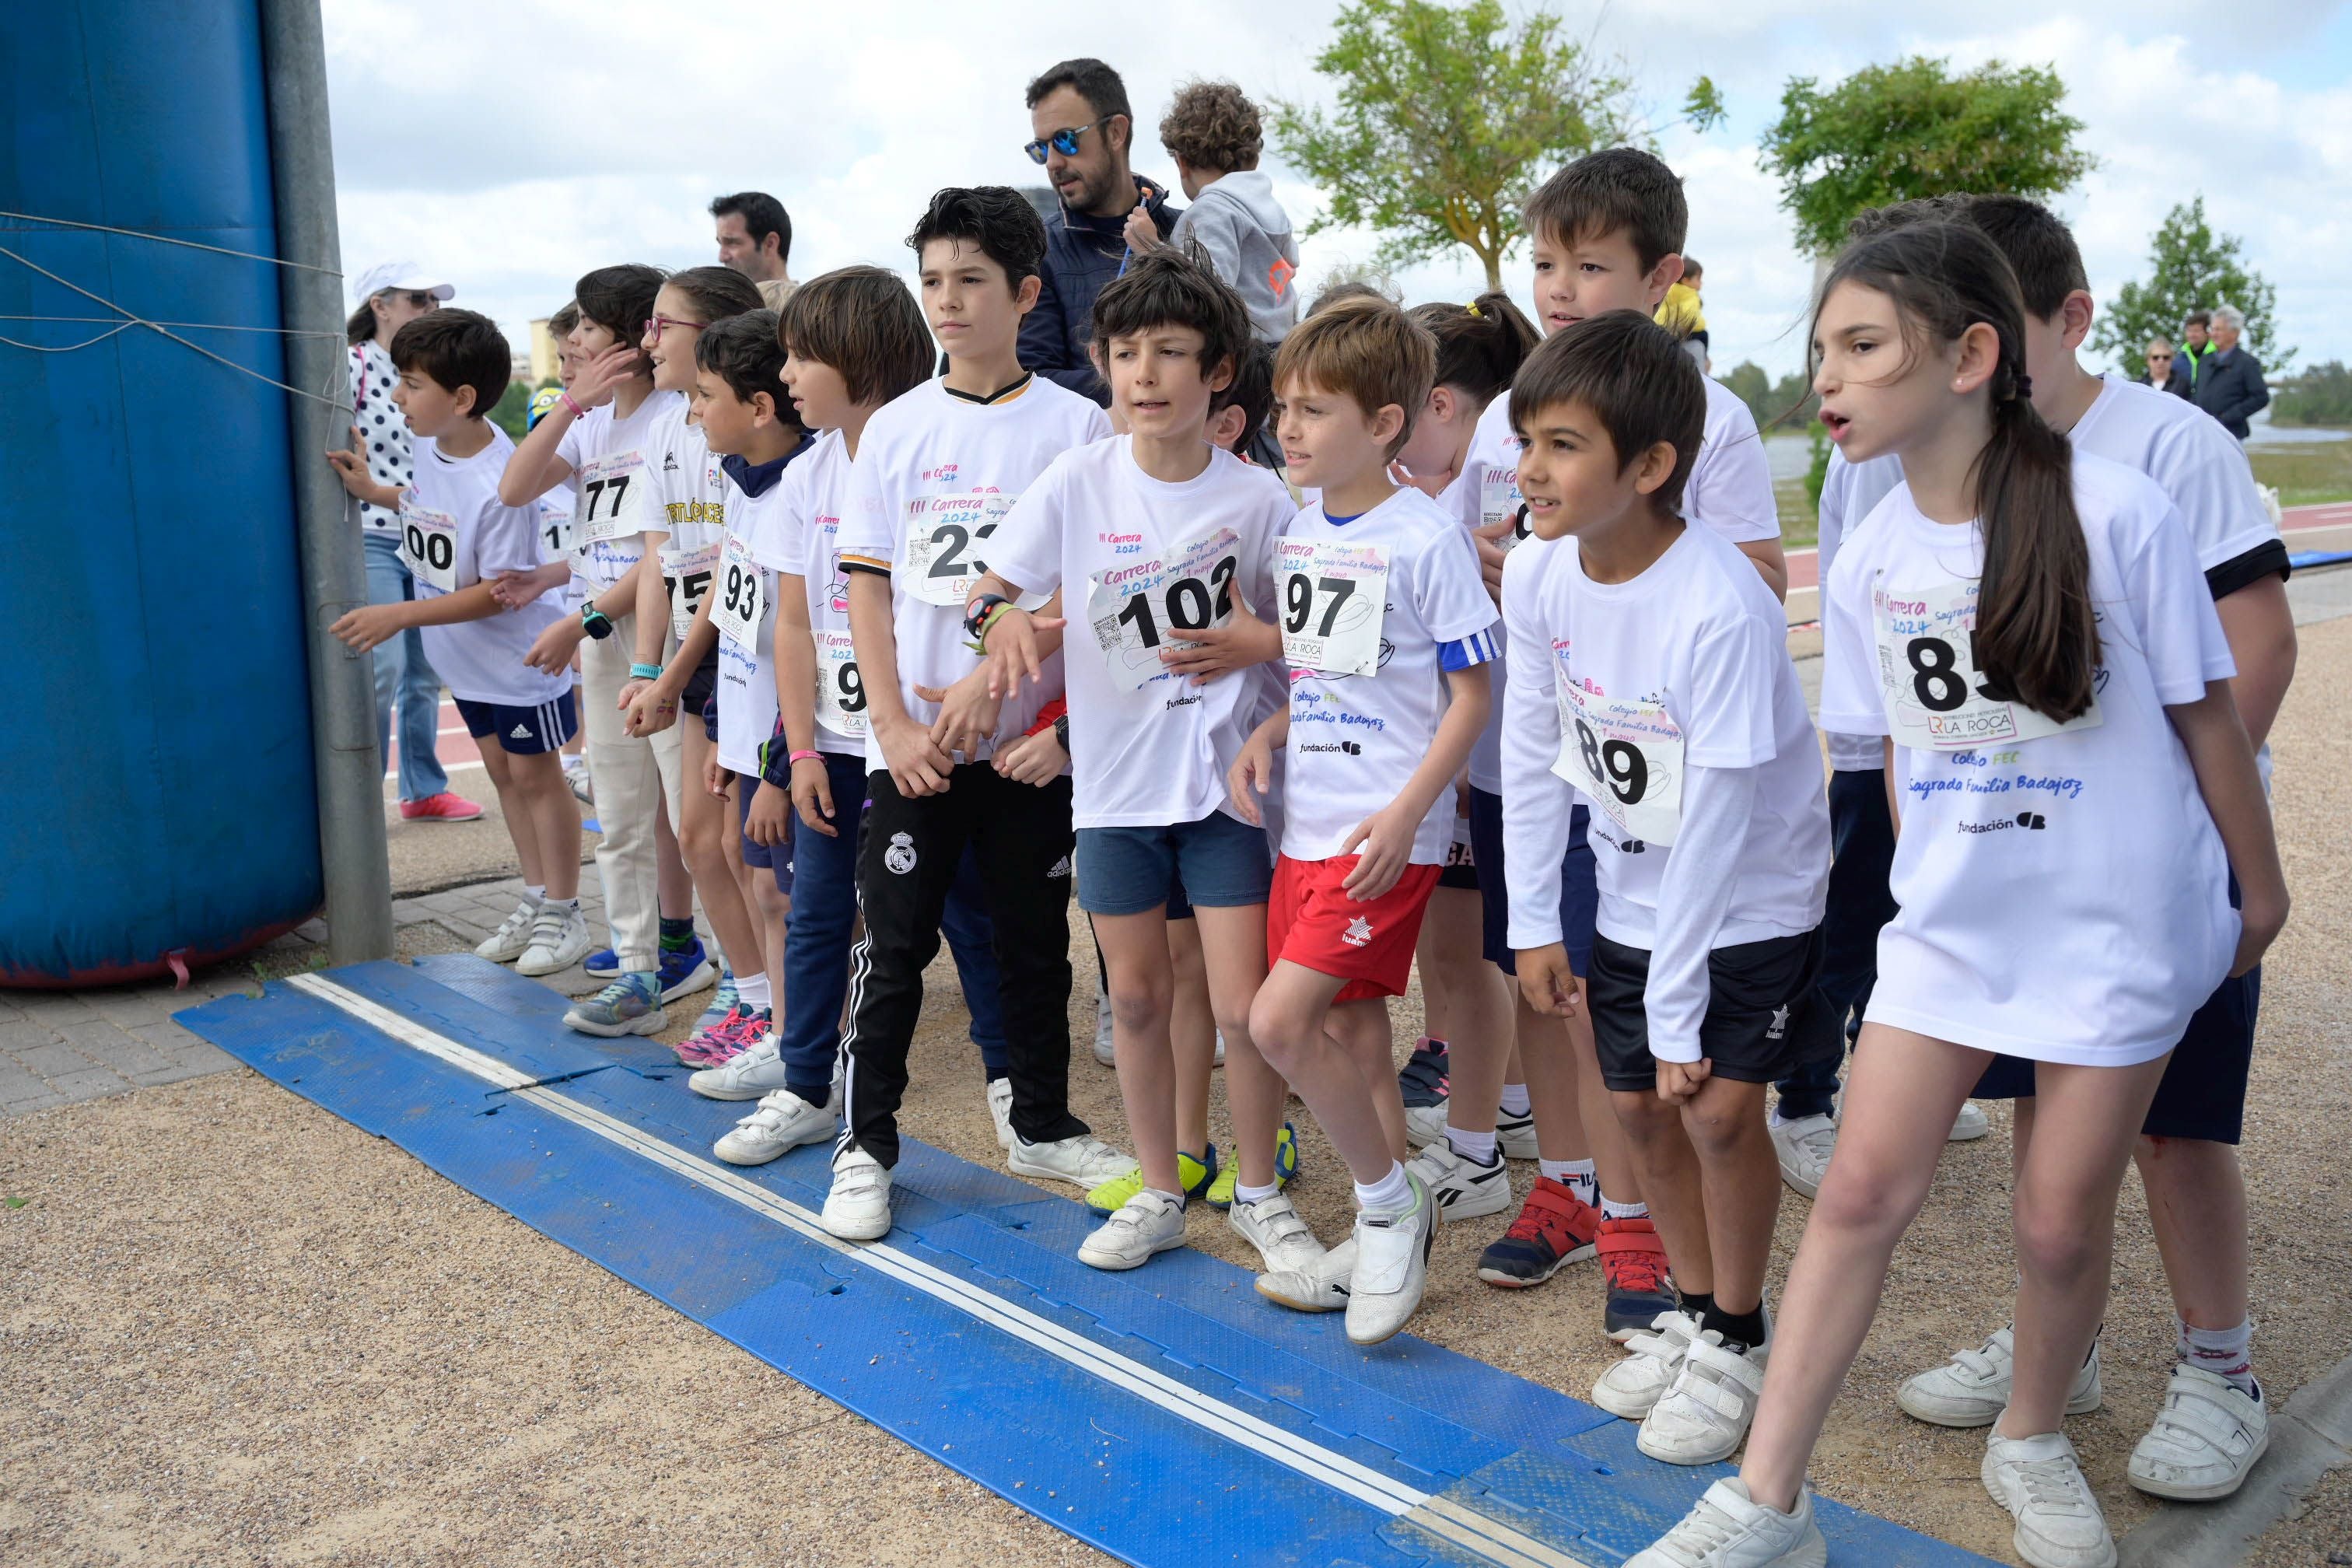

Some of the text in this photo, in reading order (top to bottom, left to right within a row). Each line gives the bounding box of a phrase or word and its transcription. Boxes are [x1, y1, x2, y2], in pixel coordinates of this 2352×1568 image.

[922, 471, 931, 481] III
[1486, 470, 1502, 483] III
[586, 475, 630, 522] 77
[910, 498, 984, 514] III Carrera
[940, 511, 983, 523] 2024
[546, 525, 570, 549] 1
[824, 525, 838, 534] 202
[1108, 533, 1142, 544] Carrera
[1187, 539, 1209, 553] Colegio
[1115, 544, 1143, 554] 2024
[1279, 541, 1314, 558] Carrera
[1335, 546, 1353, 558] Colegio
[1167, 558, 1195, 576] Sagrada
[1196, 546, 1220, 564] Familia
[1194, 561, 1214, 577] mayo
[1283, 559, 1309, 572] 2024
[1313, 556, 1388, 576] Sagrada Familia Badajoz
[1104, 559, 1164, 586] Carrera
[663, 570, 712, 615] 75
[725, 564, 757, 622] 93
[1120, 576, 1166, 597] 2024
[1118, 555, 1237, 649] 102
[1286, 573, 1356, 638] 97
[1886, 593, 1927, 617] Carrera
[1935, 605, 1977, 626] Sagrada
[1891, 618, 1932, 635] 2024
[1962, 619, 1969, 632] 1
[817, 632, 825, 644] III
[832, 649, 856, 660] 202
[1300, 642, 1321, 656] ROCA
[1294, 691, 1321, 708] Colegio
[1608, 703, 1638, 720] Colegio
[1302, 710, 1336, 723] Familia
[1340, 712, 1385, 731] Badajoz
[1944, 718, 1962, 734] LA
[1968, 714, 2012, 733] ROCA
[1609, 730, 1636, 743] mayo
[1616, 719, 1649, 733] Familia
[1650, 724, 1683, 743] Badajoz
[1300, 744, 1341, 754] fundación
[1575, 717, 1649, 806] 89
[1993, 751, 2021, 765] FEC
[1908, 777, 1963, 801] Sagrada
[2015, 774, 2084, 800] Badajoz
[1957, 818, 2014, 834] fundación
[1047, 866, 1072, 878] adidas
